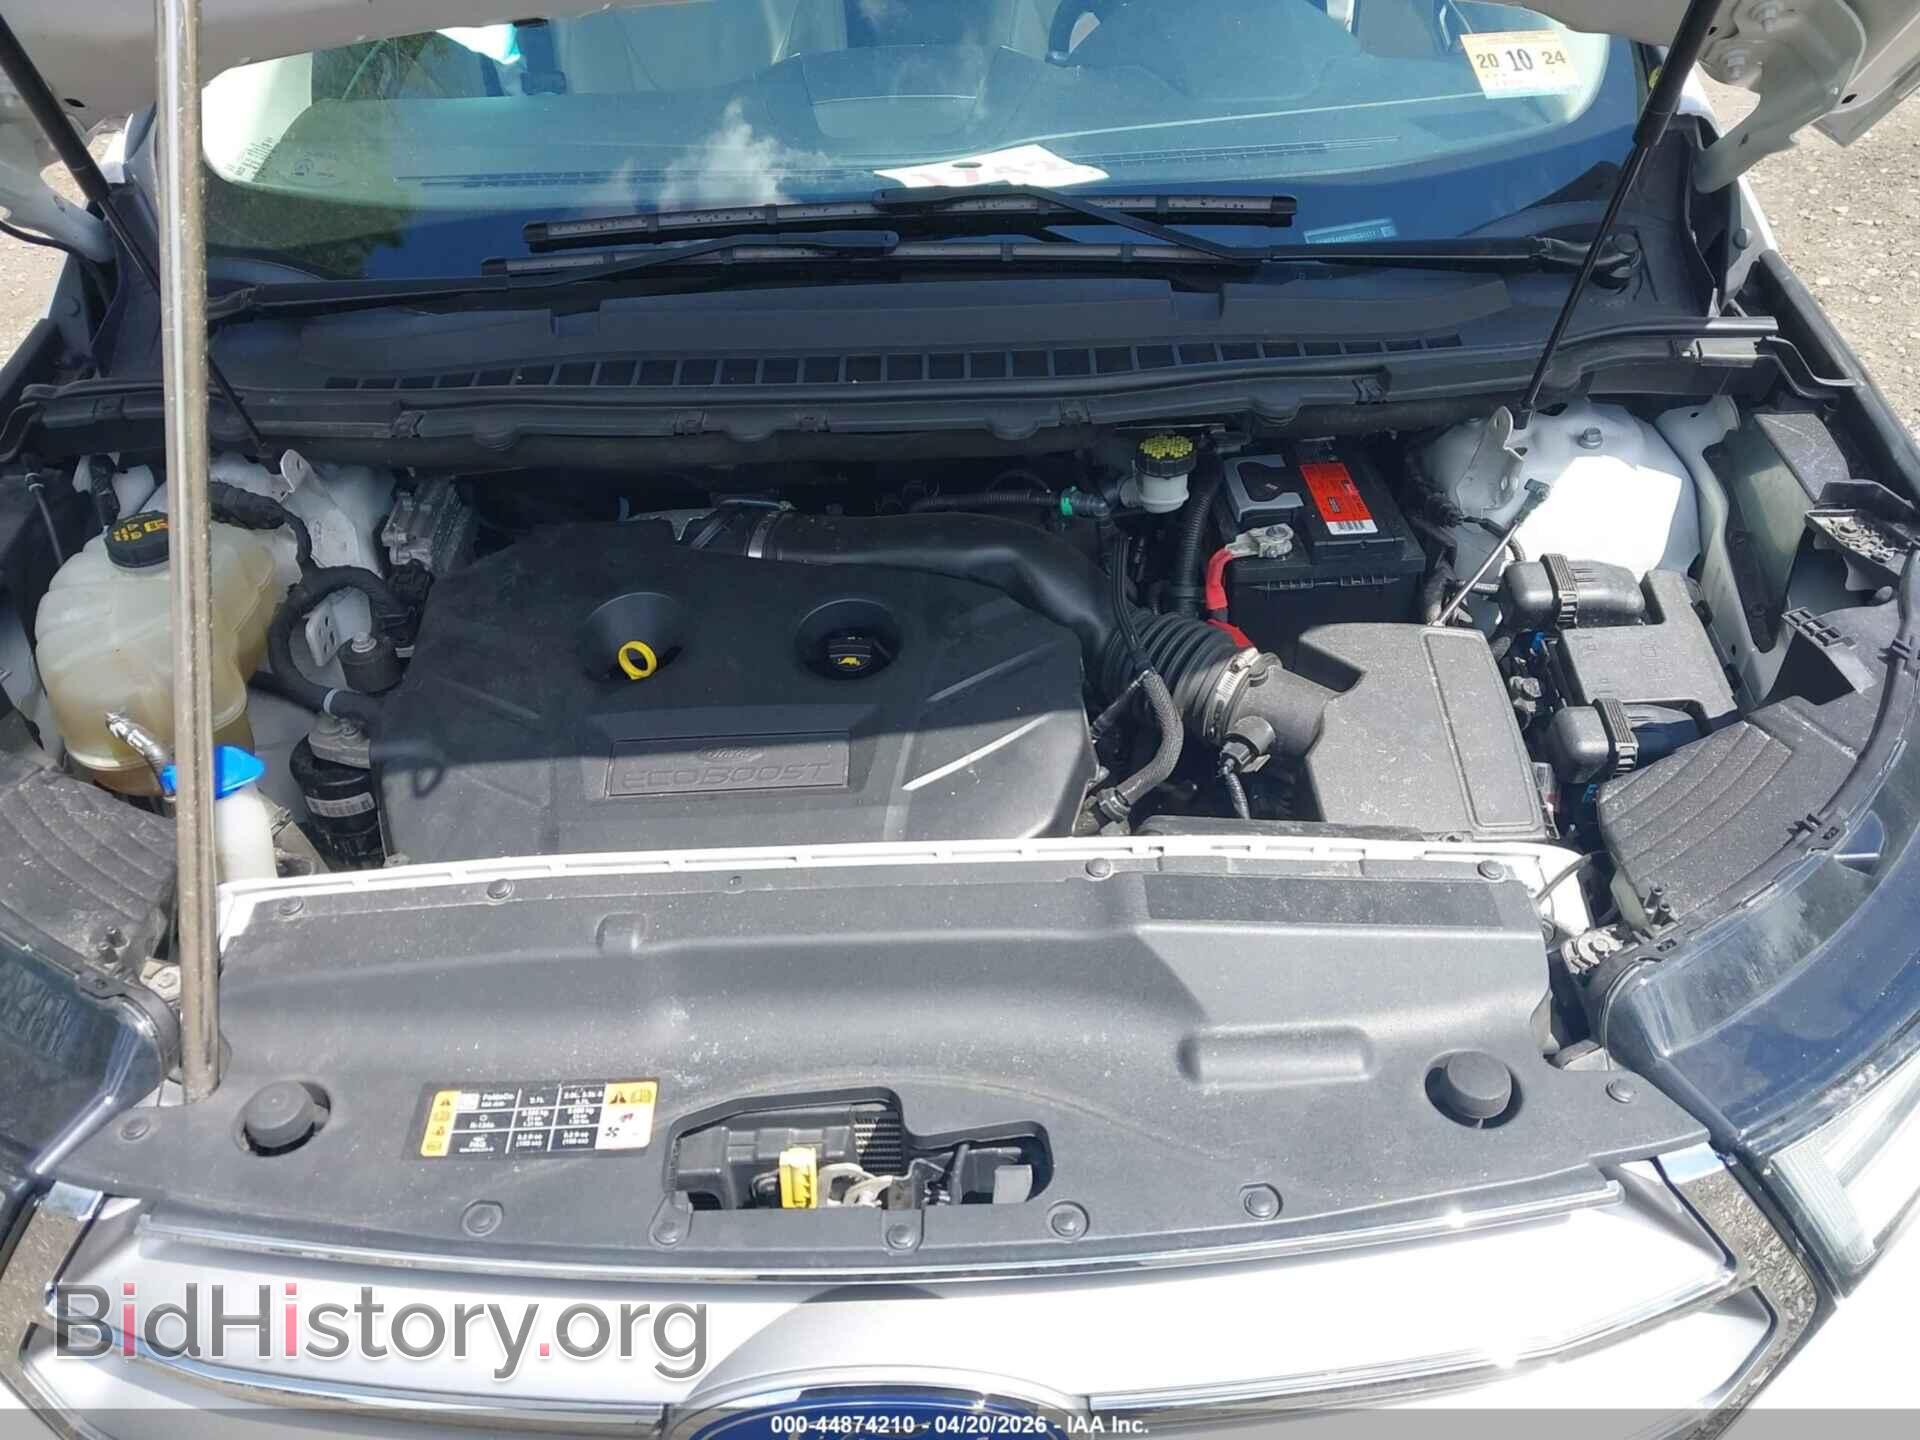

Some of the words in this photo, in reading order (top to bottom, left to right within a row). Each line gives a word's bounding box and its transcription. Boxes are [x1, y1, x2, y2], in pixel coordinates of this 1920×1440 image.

[1476, 53, 1499, 69] 20
[1505, 48, 1534, 72] 10
[1541, 50, 1566, 65] 24
[622, 762, 832, 790] ECOBOOST
